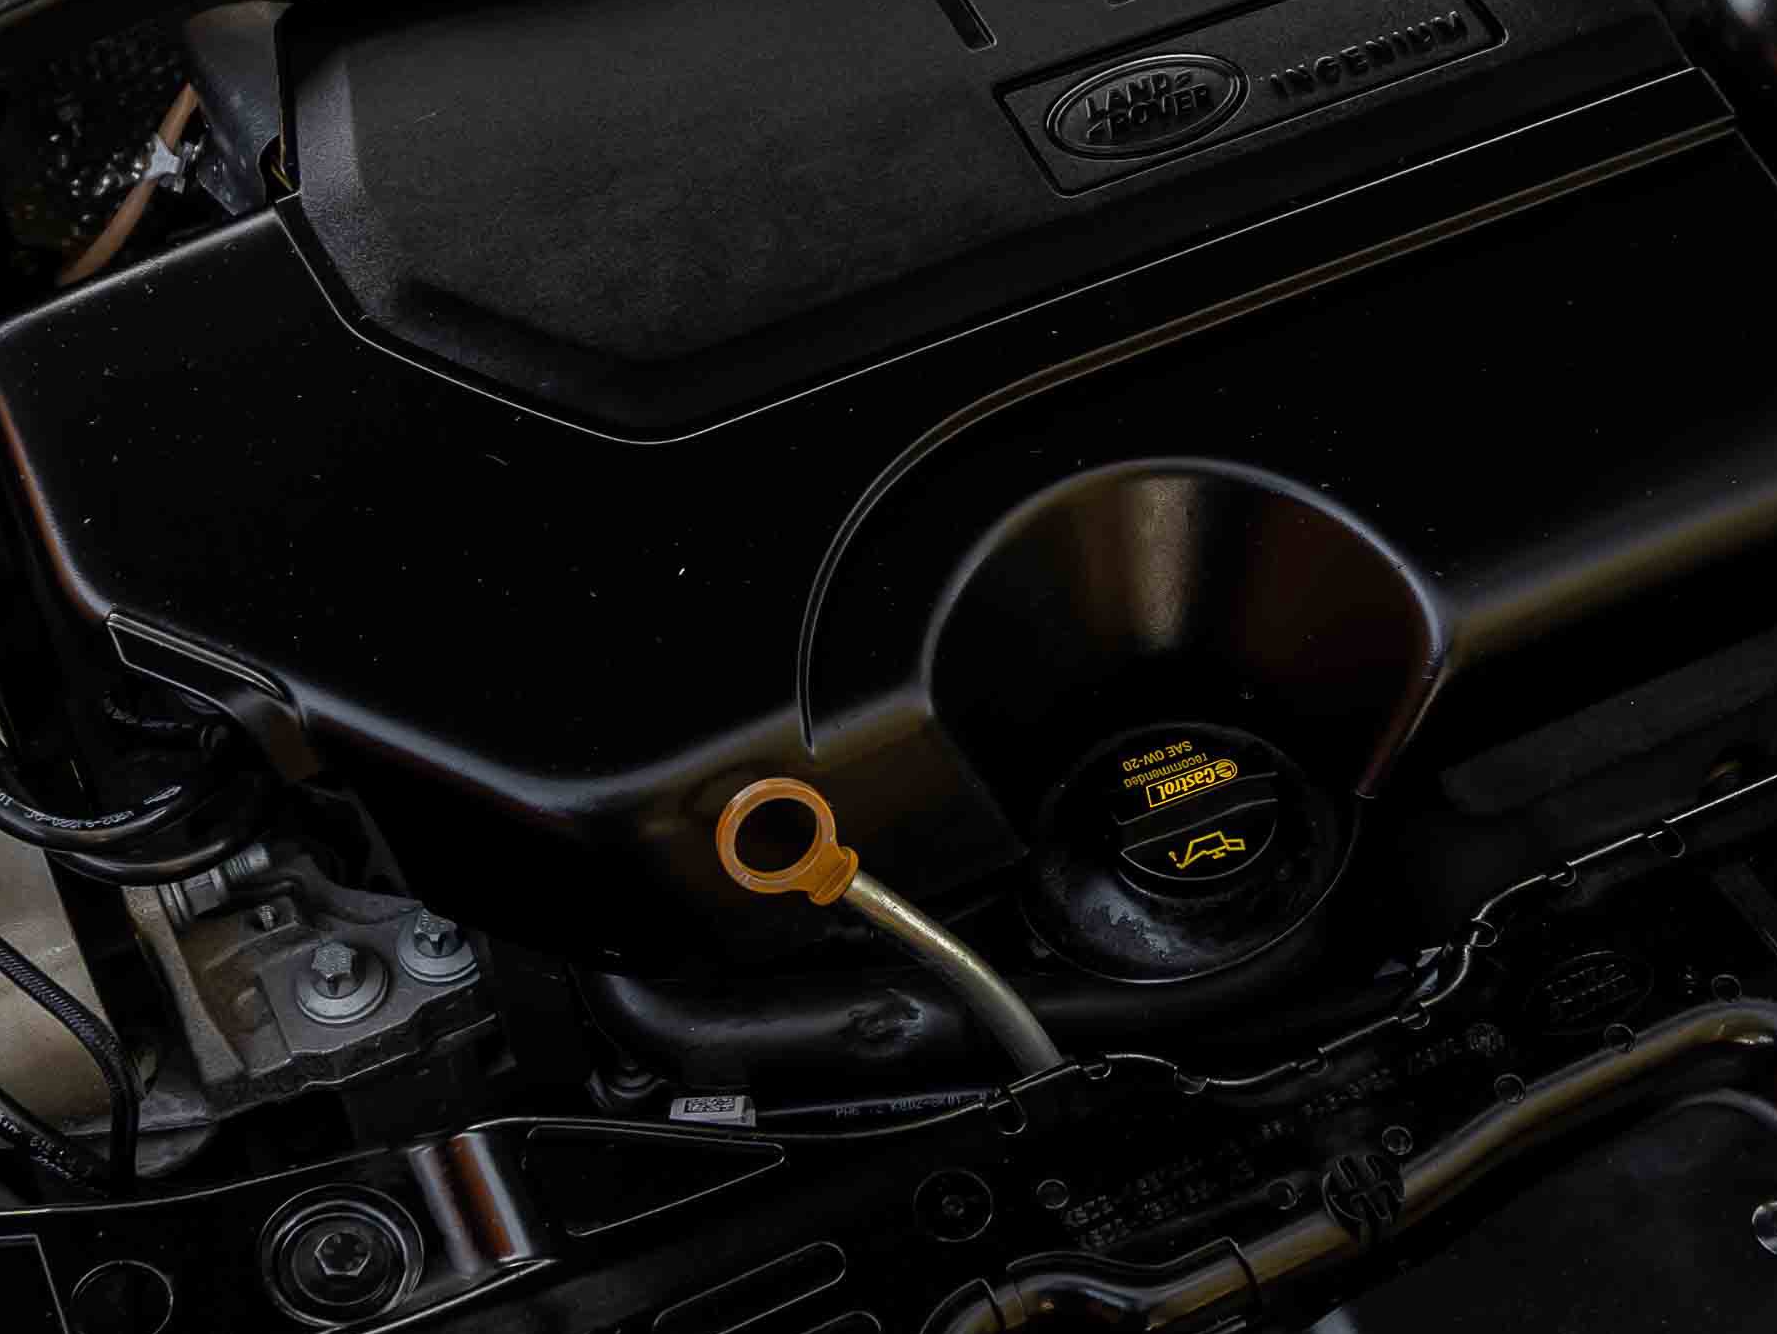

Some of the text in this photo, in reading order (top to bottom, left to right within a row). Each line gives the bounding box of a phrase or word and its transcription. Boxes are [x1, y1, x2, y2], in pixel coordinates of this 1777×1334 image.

[1269, 10, 1468, 98] INGENIUM
[1085, 72, 1169, 120] LAND
[1106, 83, 1208, 140] ROVER
[1122, 740, 1193, 772] SAE 0W-20
[1156, 766, 1215, 801] Castrol
